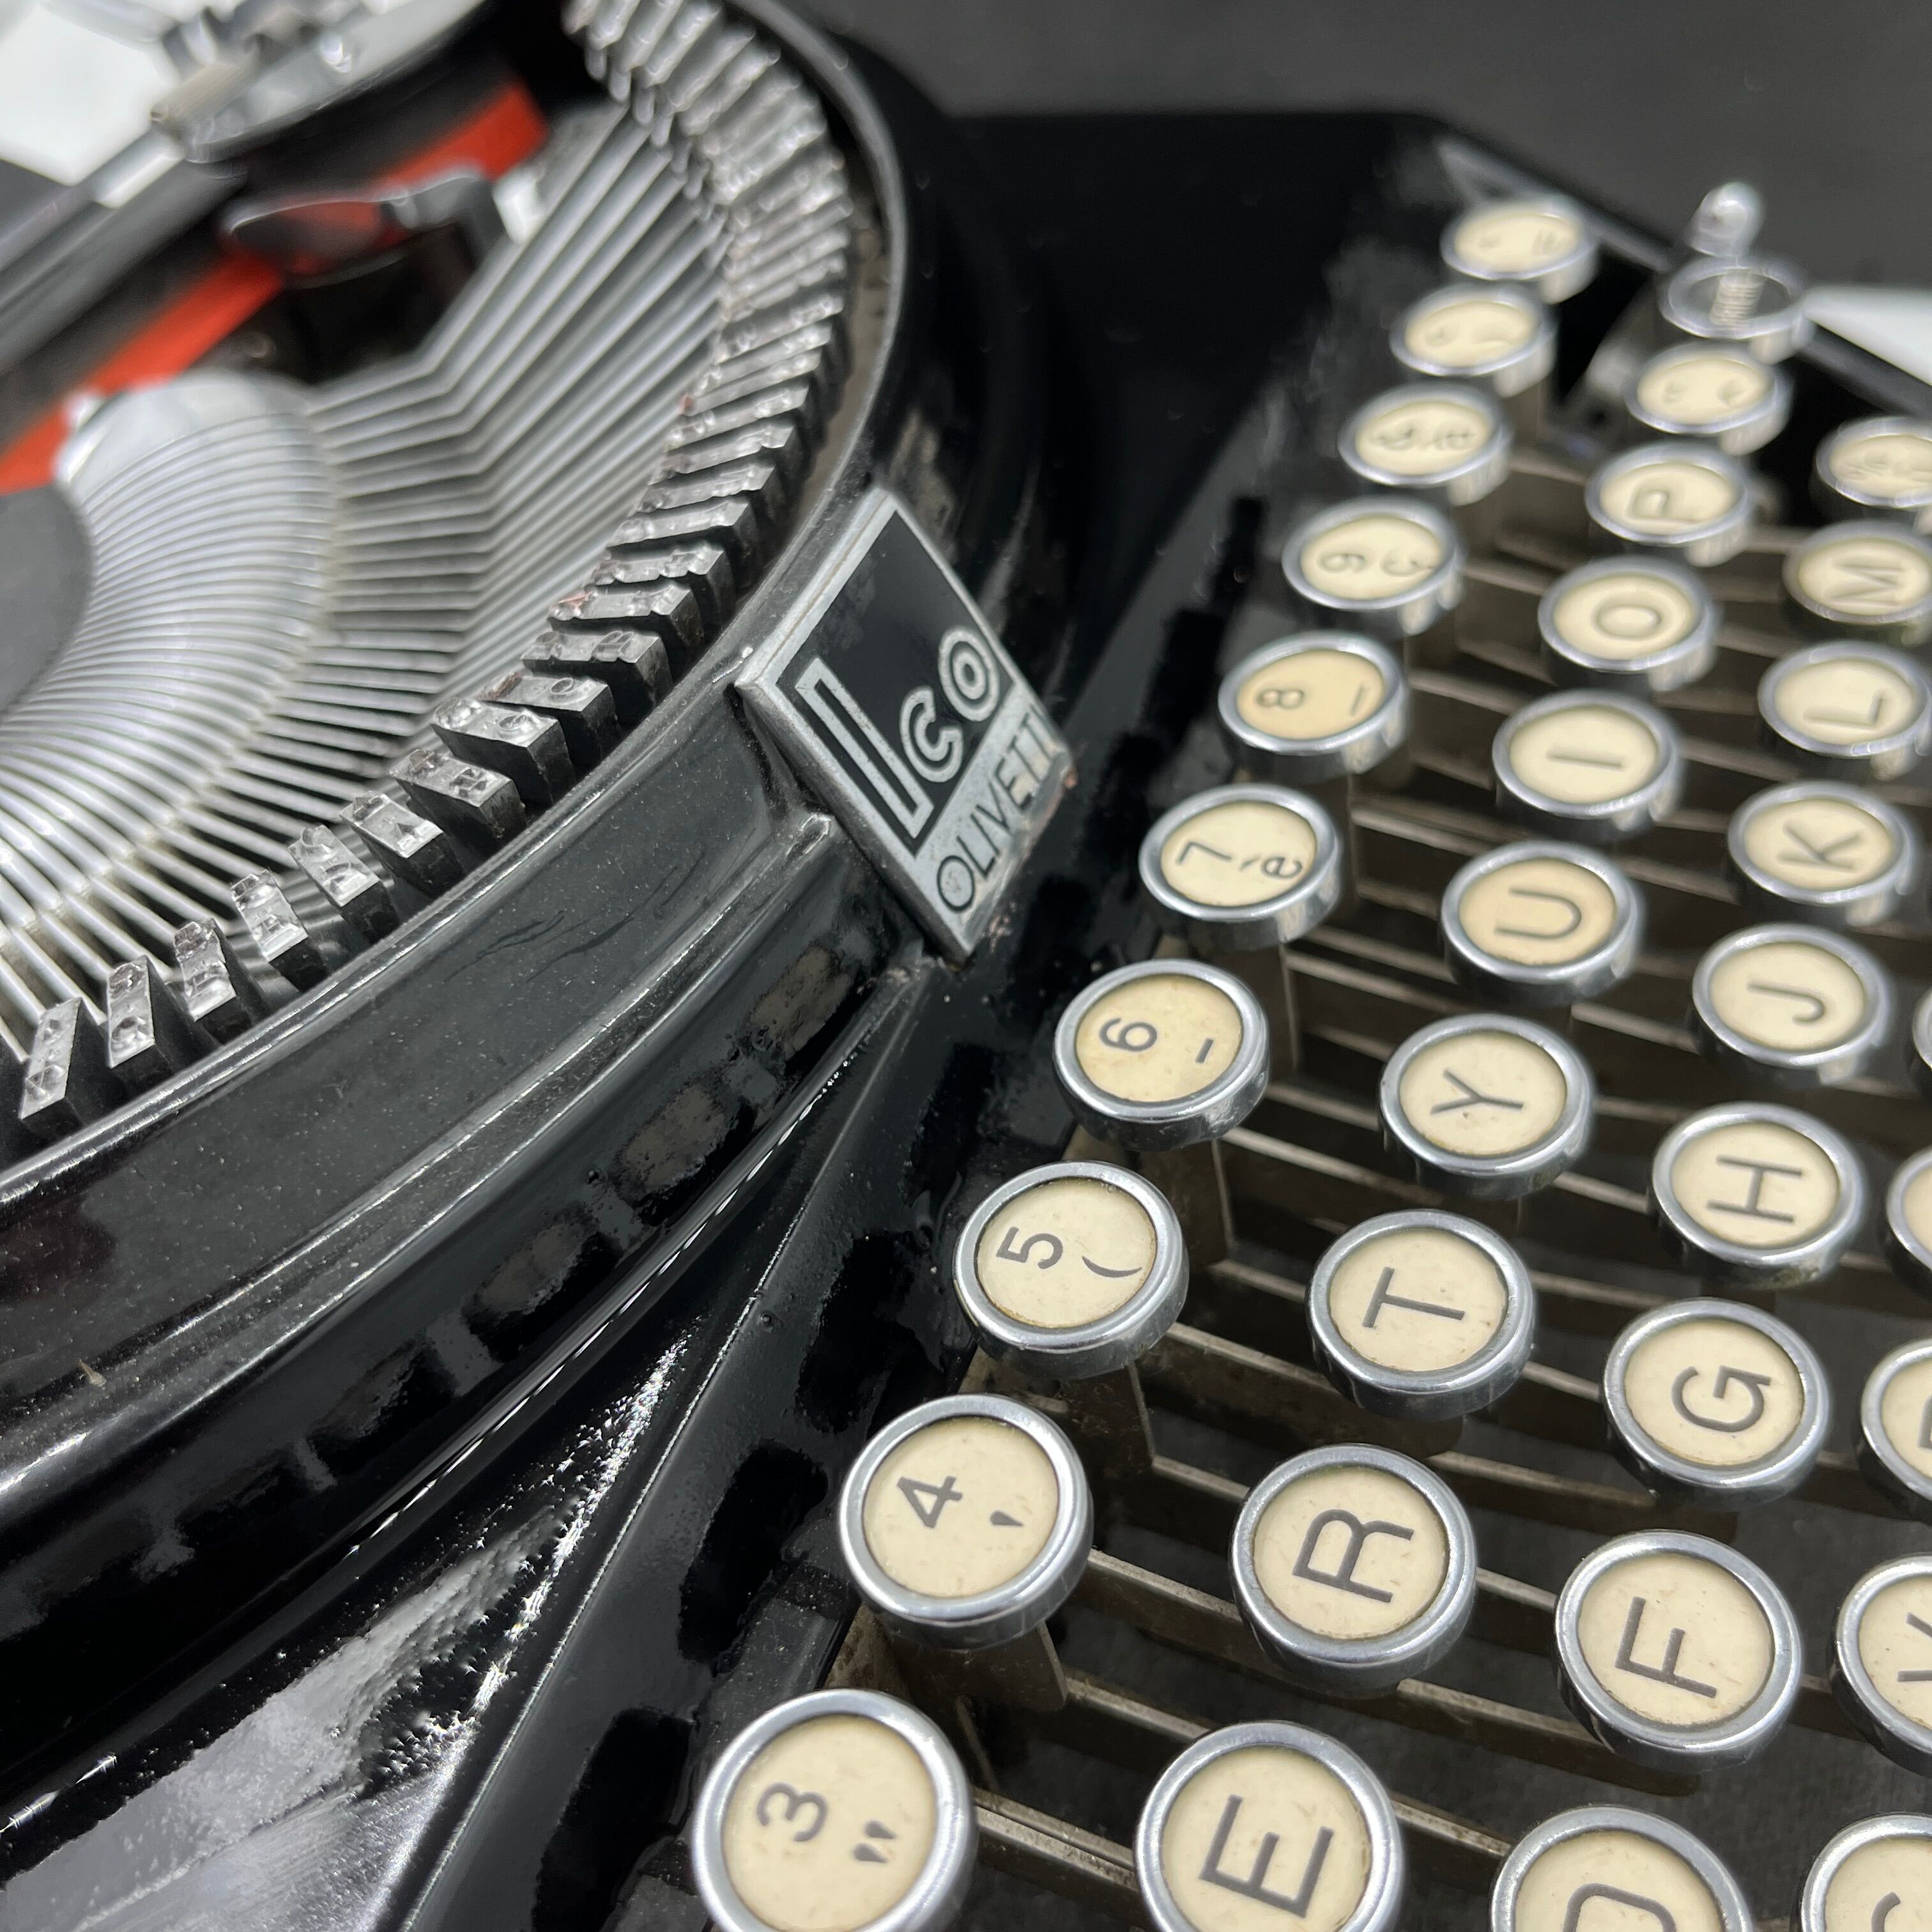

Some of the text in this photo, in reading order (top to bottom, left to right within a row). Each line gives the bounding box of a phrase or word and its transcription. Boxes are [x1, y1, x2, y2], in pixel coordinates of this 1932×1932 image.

[1628, 486, 1699, 523] P
[1832, 563, 1905, 607] M
[1593, 600, 1664, 639] O
[1256, 687, 1305, 710] 8
[1803, 691, 1885, 728] L
[1547, 752, 1624, 769] I
[937, 704, 1055, 912] OLIVETTI
[1176, 840, 1234, 867] 7
[1778, 822, 1866, 870] K
[1495, 888, 1583, 941] U
[1749, 983, 1828, 1025] J
[1100, 1018, 1157, 1052] 6
[1431, 1069, 1524, 1116] Y
[1706, 1155, 1804, 1223] H
[996, 1226, 1064, 1270] 5
[1362, 1268, 1465, 1329] T
[1672, 1366, 1772, 1433] G
[897, 1476, 963, 1529] 4
[1292, 1509, 1414, 1604] R
[1614, 1597, 1717, 1699] F
[756, 1782, 829, 1843] 3
[1199, 1795, 1334, 1919] E
